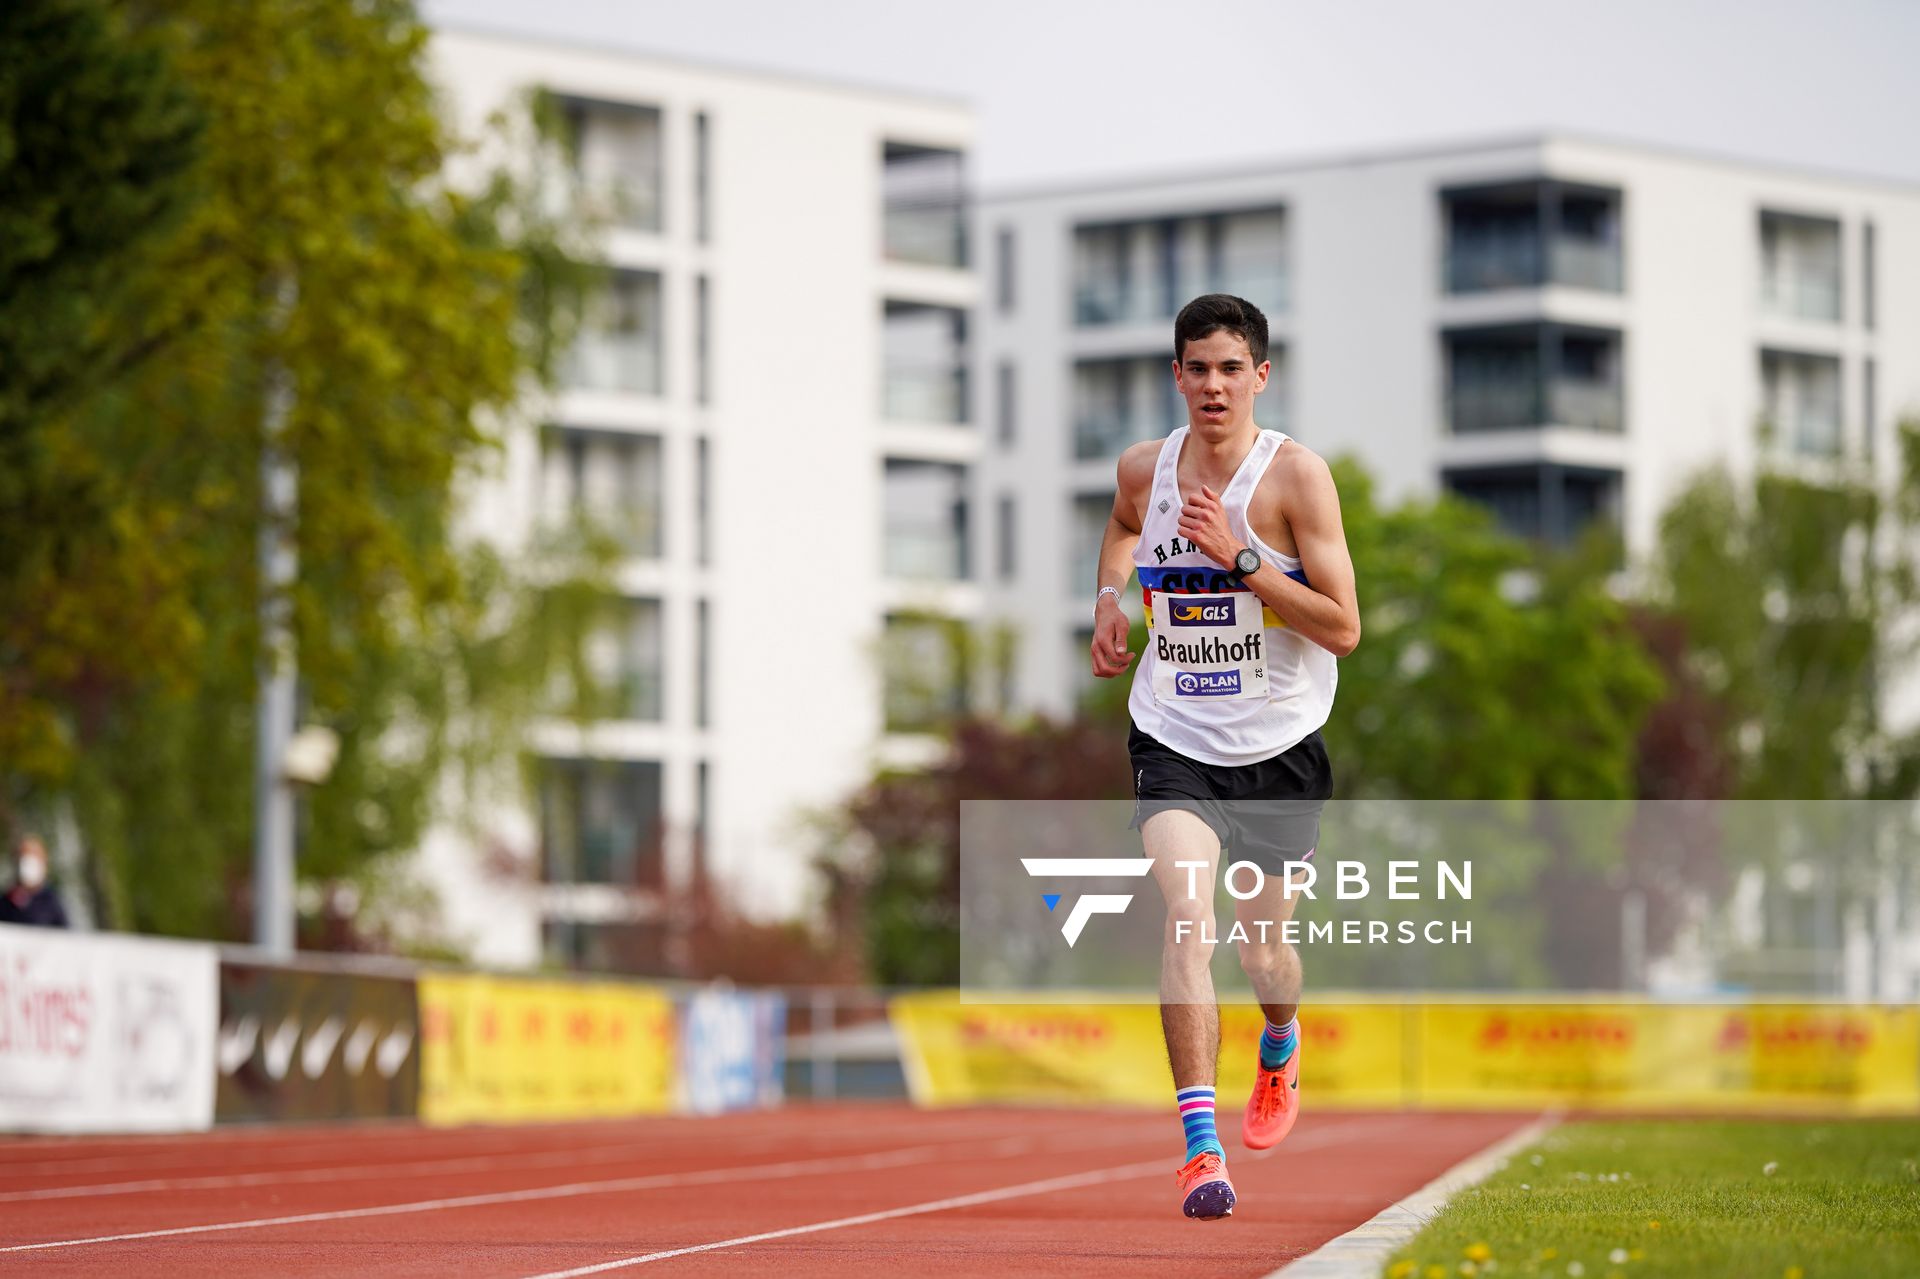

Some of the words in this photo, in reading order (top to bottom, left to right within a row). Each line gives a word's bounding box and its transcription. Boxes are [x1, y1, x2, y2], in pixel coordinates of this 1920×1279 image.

[1202, 606, 1229, 621] GLS
[1157, 633, 1261, 664] Braukhoff
[1254, 667, 1264, 679] 32
[1200, 675, 1238, 688] PLAN
